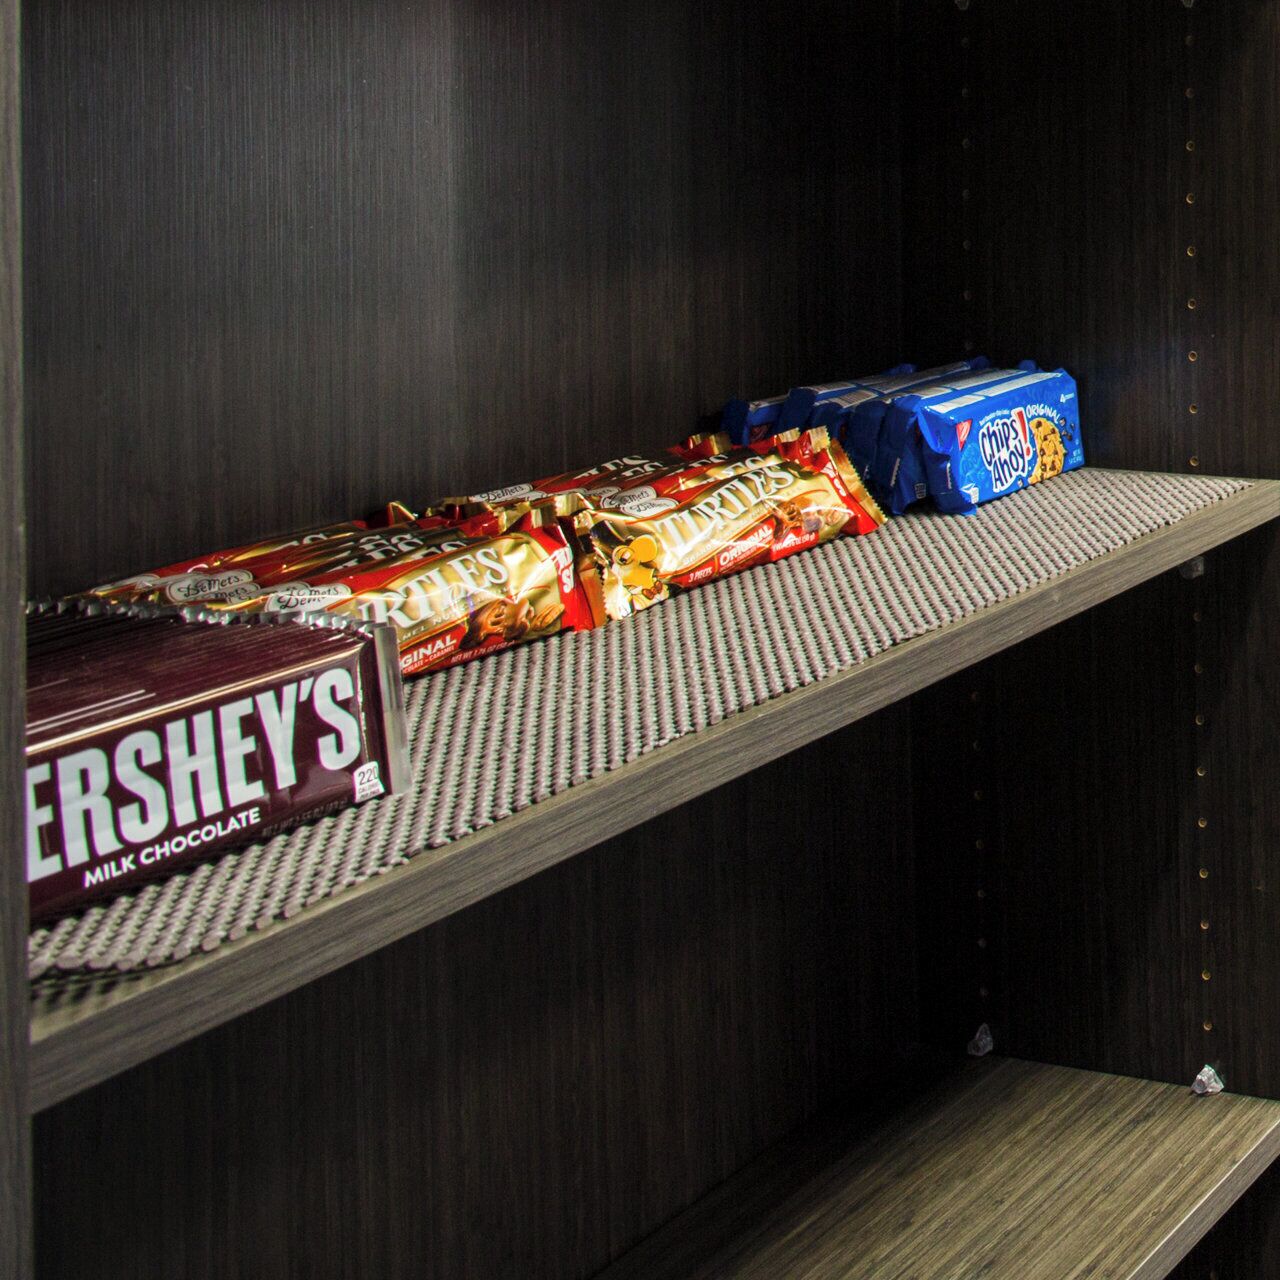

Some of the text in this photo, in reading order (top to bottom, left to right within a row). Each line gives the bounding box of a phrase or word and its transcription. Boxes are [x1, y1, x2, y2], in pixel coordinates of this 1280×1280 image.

[981, 418, 1019, 468] Chips
[1026, 403, 1061, 424] ORIGINAL
[654, 465, 795, 554] TURTLES
[358, 546, 509, 629] RTLES
[401, 634, 457, 668] GINAL
[25, 668, 361, 883] ERSHEY'S
[358, 765, 379, 786] 220
[84, 806, 262, 888] MILK CHOCOLATE
